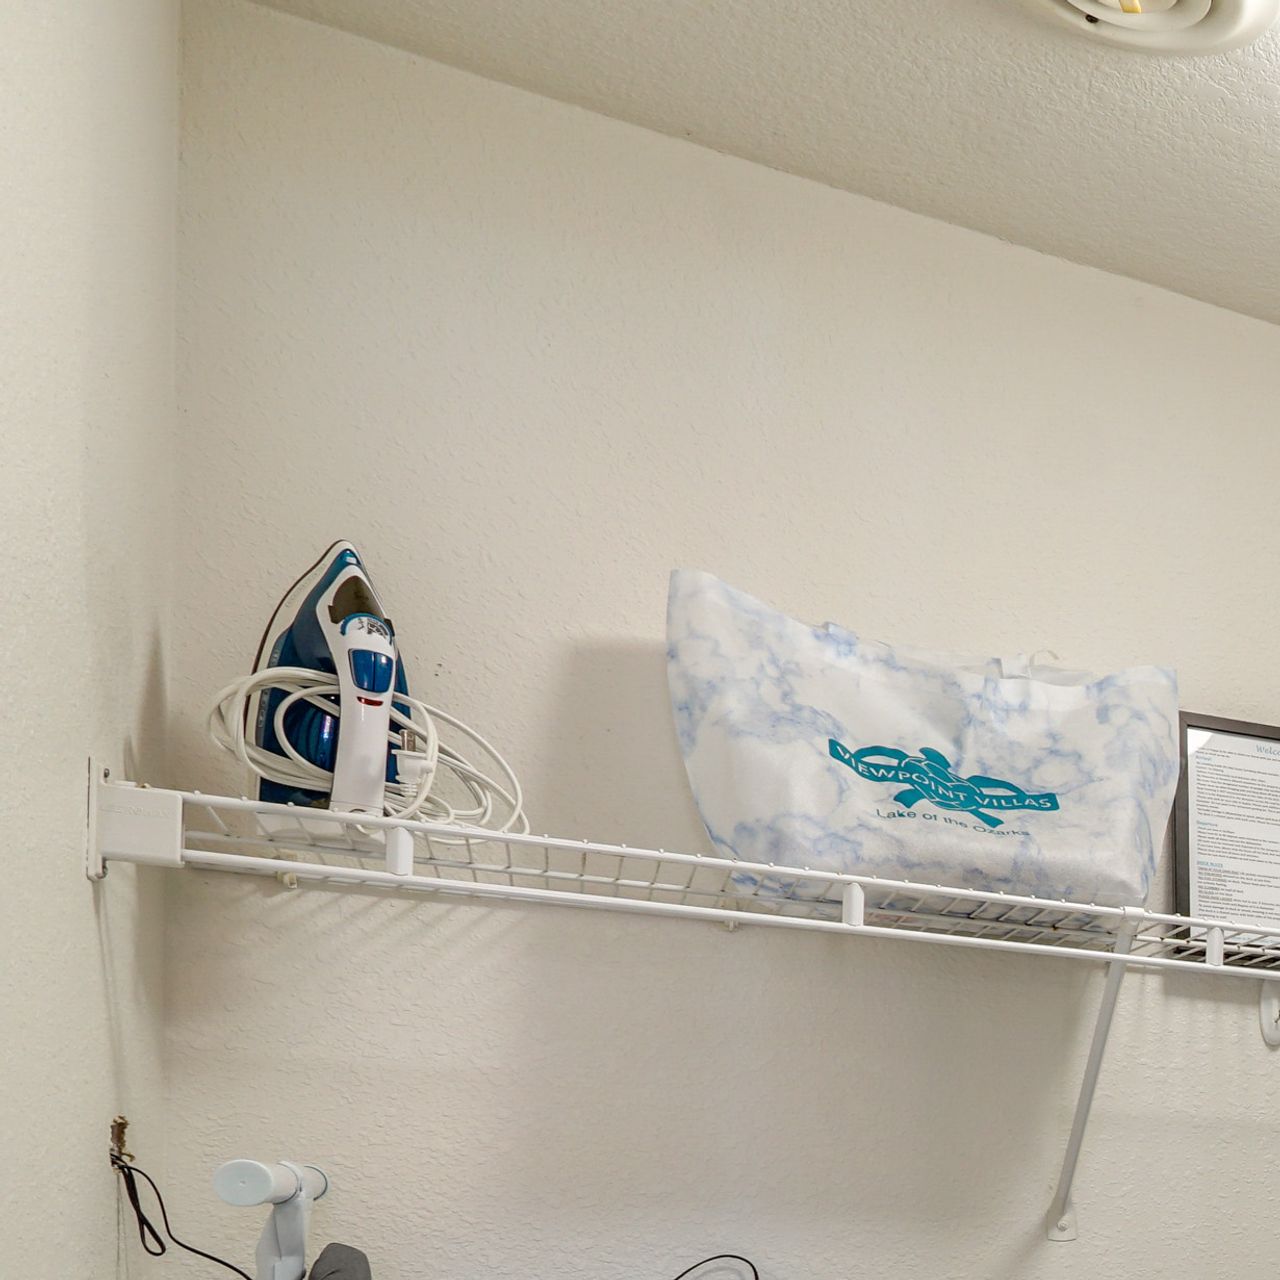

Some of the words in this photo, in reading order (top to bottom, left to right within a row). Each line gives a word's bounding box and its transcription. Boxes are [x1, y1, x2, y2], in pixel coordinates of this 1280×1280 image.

[836, 745, 967, 801] VIEWPOINT
[974, 794, 1052, 808] VILLAS
[876, 808, 917, 820] Lake
[922, 813, 938, 821] of
[944, 817, 968, 828] the
[973, 825, 1031, 837] Ozarks
